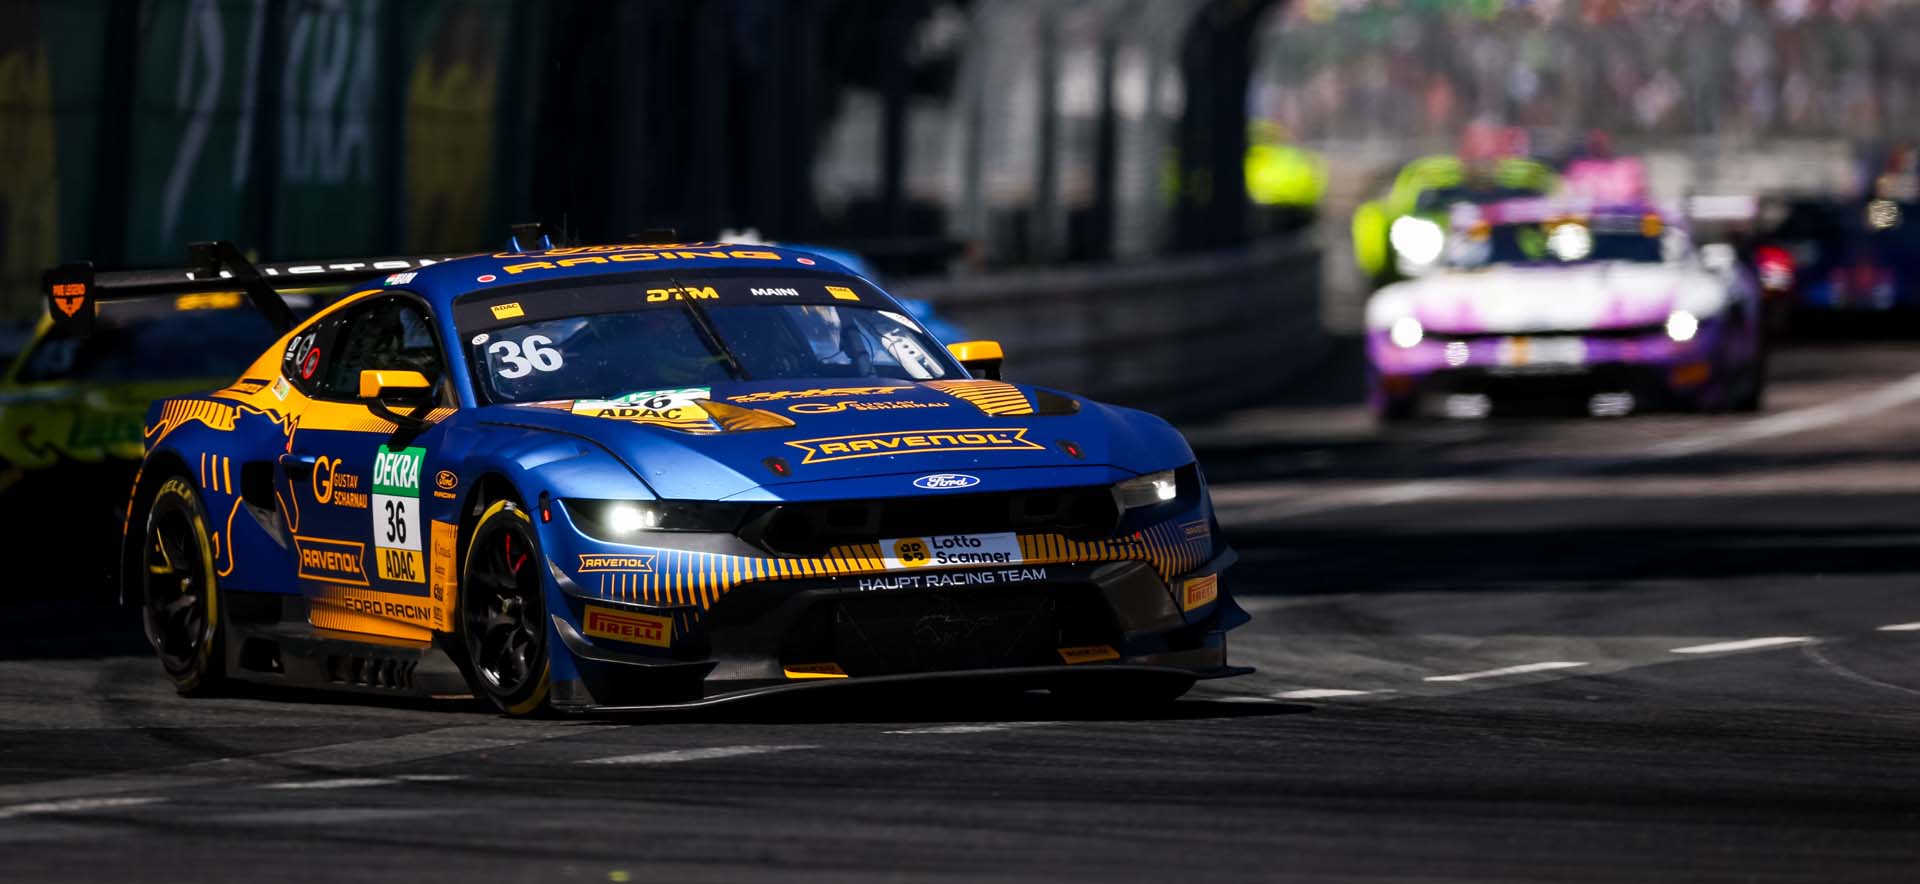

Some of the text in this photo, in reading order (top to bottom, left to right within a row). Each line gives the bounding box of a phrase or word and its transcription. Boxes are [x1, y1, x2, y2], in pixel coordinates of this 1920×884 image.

[503, 250, 781, 274] RACING
[647, 286, 720, 302] DTM
[750, 288, 799, 296] MAINI
[494, 304, 518, 312] ADAC
[489, 335, 563, 379] 36
[597, 408, 682, 420] ADAC
[818, 433, 1013, 455] RAVENOL
[334, 472, 359, 489] GUSTAV
[374, 453, 419, 489] DEKRA
[927, 475, 967, 487] Ford
[334, 490, 368, 509] SCHARNAU
[386, 500, 406, 543] 36
[931, 536, 981, 549] Lotto
[303, 548, 361, 573] RAVENOL
[386, 550, 415, 580] ADAC
[585, 558, 645, 568] RAVENOL
[937, 551, 1011, 564] Scanner
[859, 567, 1047, 591] HAUPT RACING TEAM
[589, 611, 664, 640] PIRELLI
